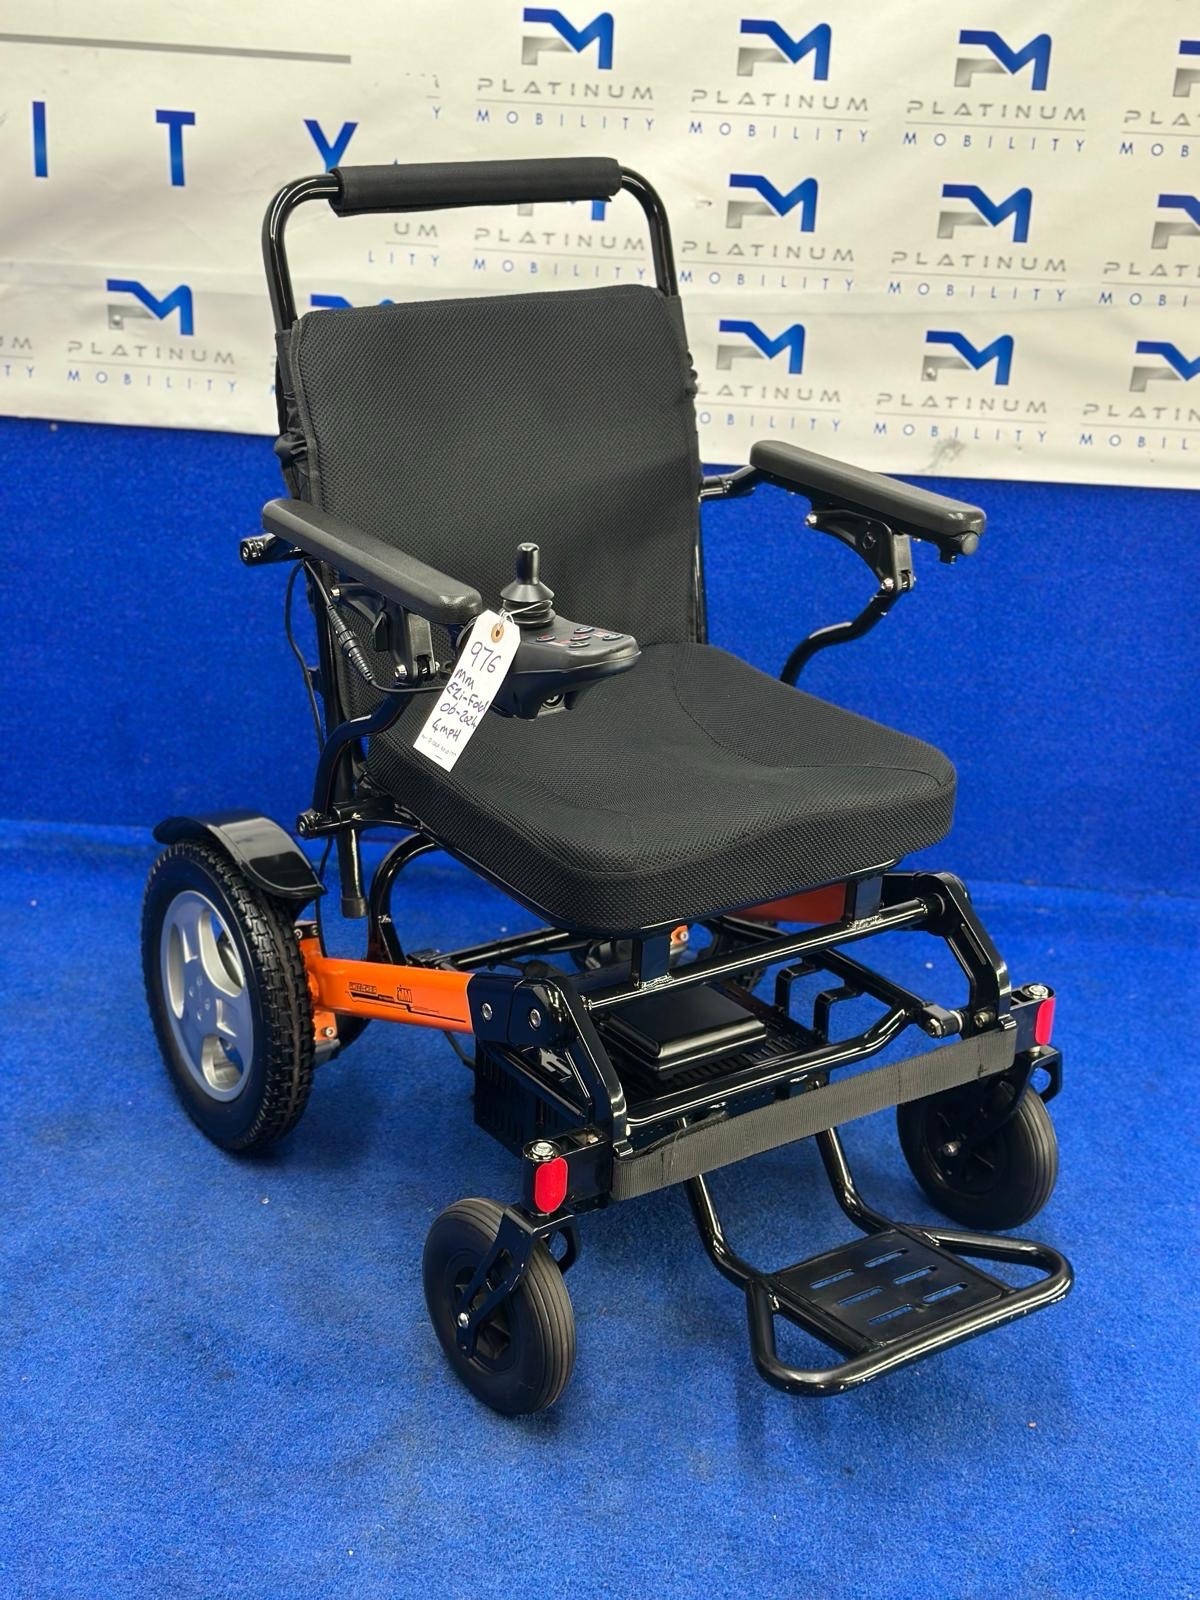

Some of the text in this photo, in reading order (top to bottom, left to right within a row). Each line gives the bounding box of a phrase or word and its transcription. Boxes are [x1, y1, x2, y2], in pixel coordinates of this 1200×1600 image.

[476, 76, 654, 103] PLATINUM
[689, 88, 870, 114] PLATINUM
[475, 109, 656, 132] MOBILITY
[905, 99, 1087, 123] PLATINUM
[1123, 109, 1200, 127] PLA
[688, 121, 871, 144] MOBILITY
[902, 131, 1087, 153] MOBILITY
[473, 226, 646, 252] PLATINUM
[680, 239, 855, 263] PLATINUM
[472, 257, 647, 281] MOBILITY
[890, 250, 1067, 274] PLATINUM
[678, 270, 855, 292] MOBILITY
[887, 281, 1067, 303] MOBILITY
[66, 340, 236, 366] PLATINUM
[66, 369, 238, 394] MOBILITY
[875, 391, 1048, 415] PLATINUM
[873, 421, 1048, 444] MOBILITY
[470, 641, 502, 673] 976
